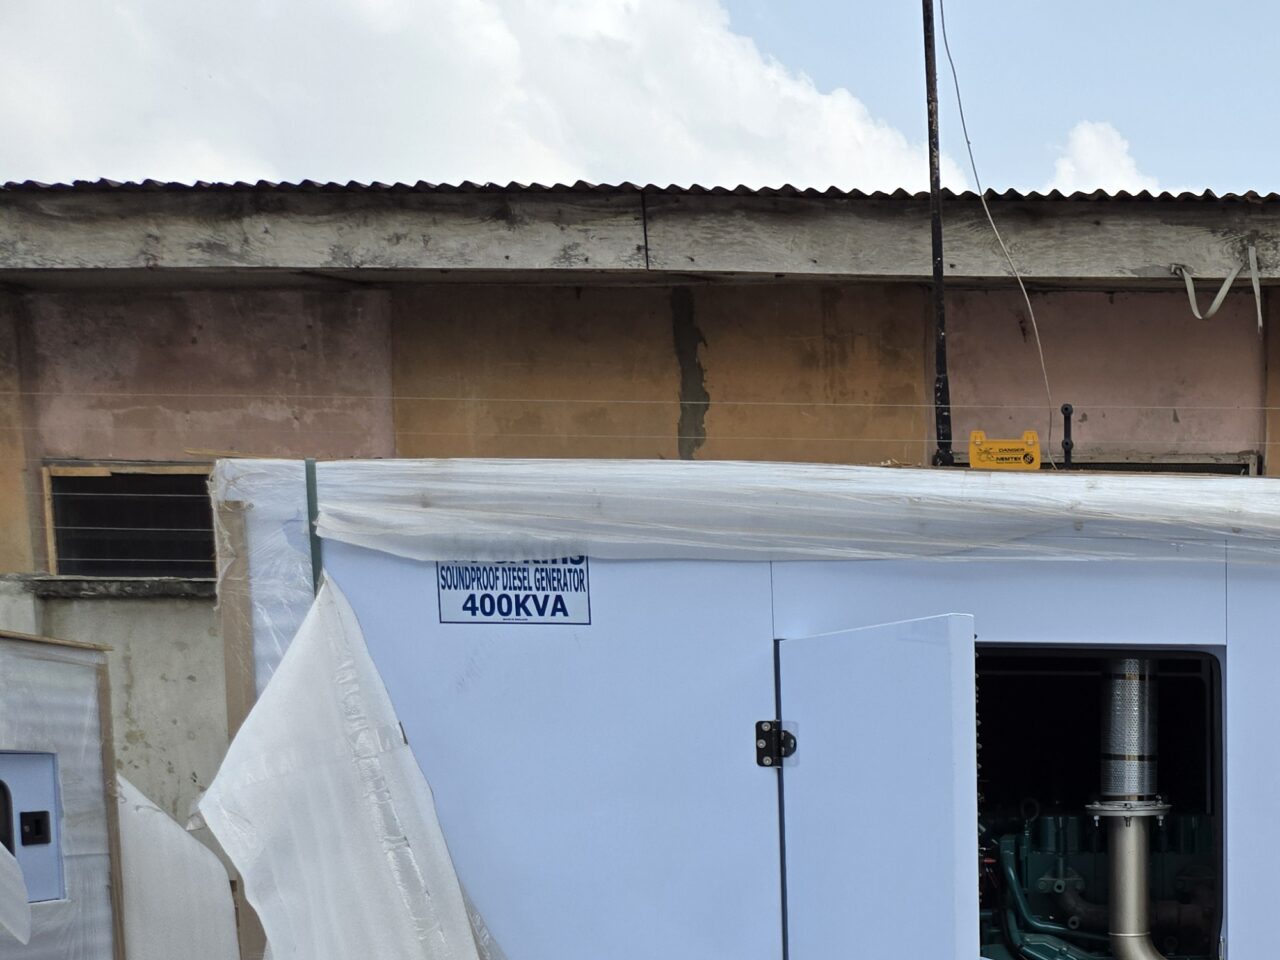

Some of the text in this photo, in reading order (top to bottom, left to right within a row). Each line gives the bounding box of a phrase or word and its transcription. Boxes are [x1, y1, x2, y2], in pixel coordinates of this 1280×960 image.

[440, 565, 586, 593] SOUNDPROOF DIESEL GENERATOR
[462, 593, 569, 617] 400KVA
